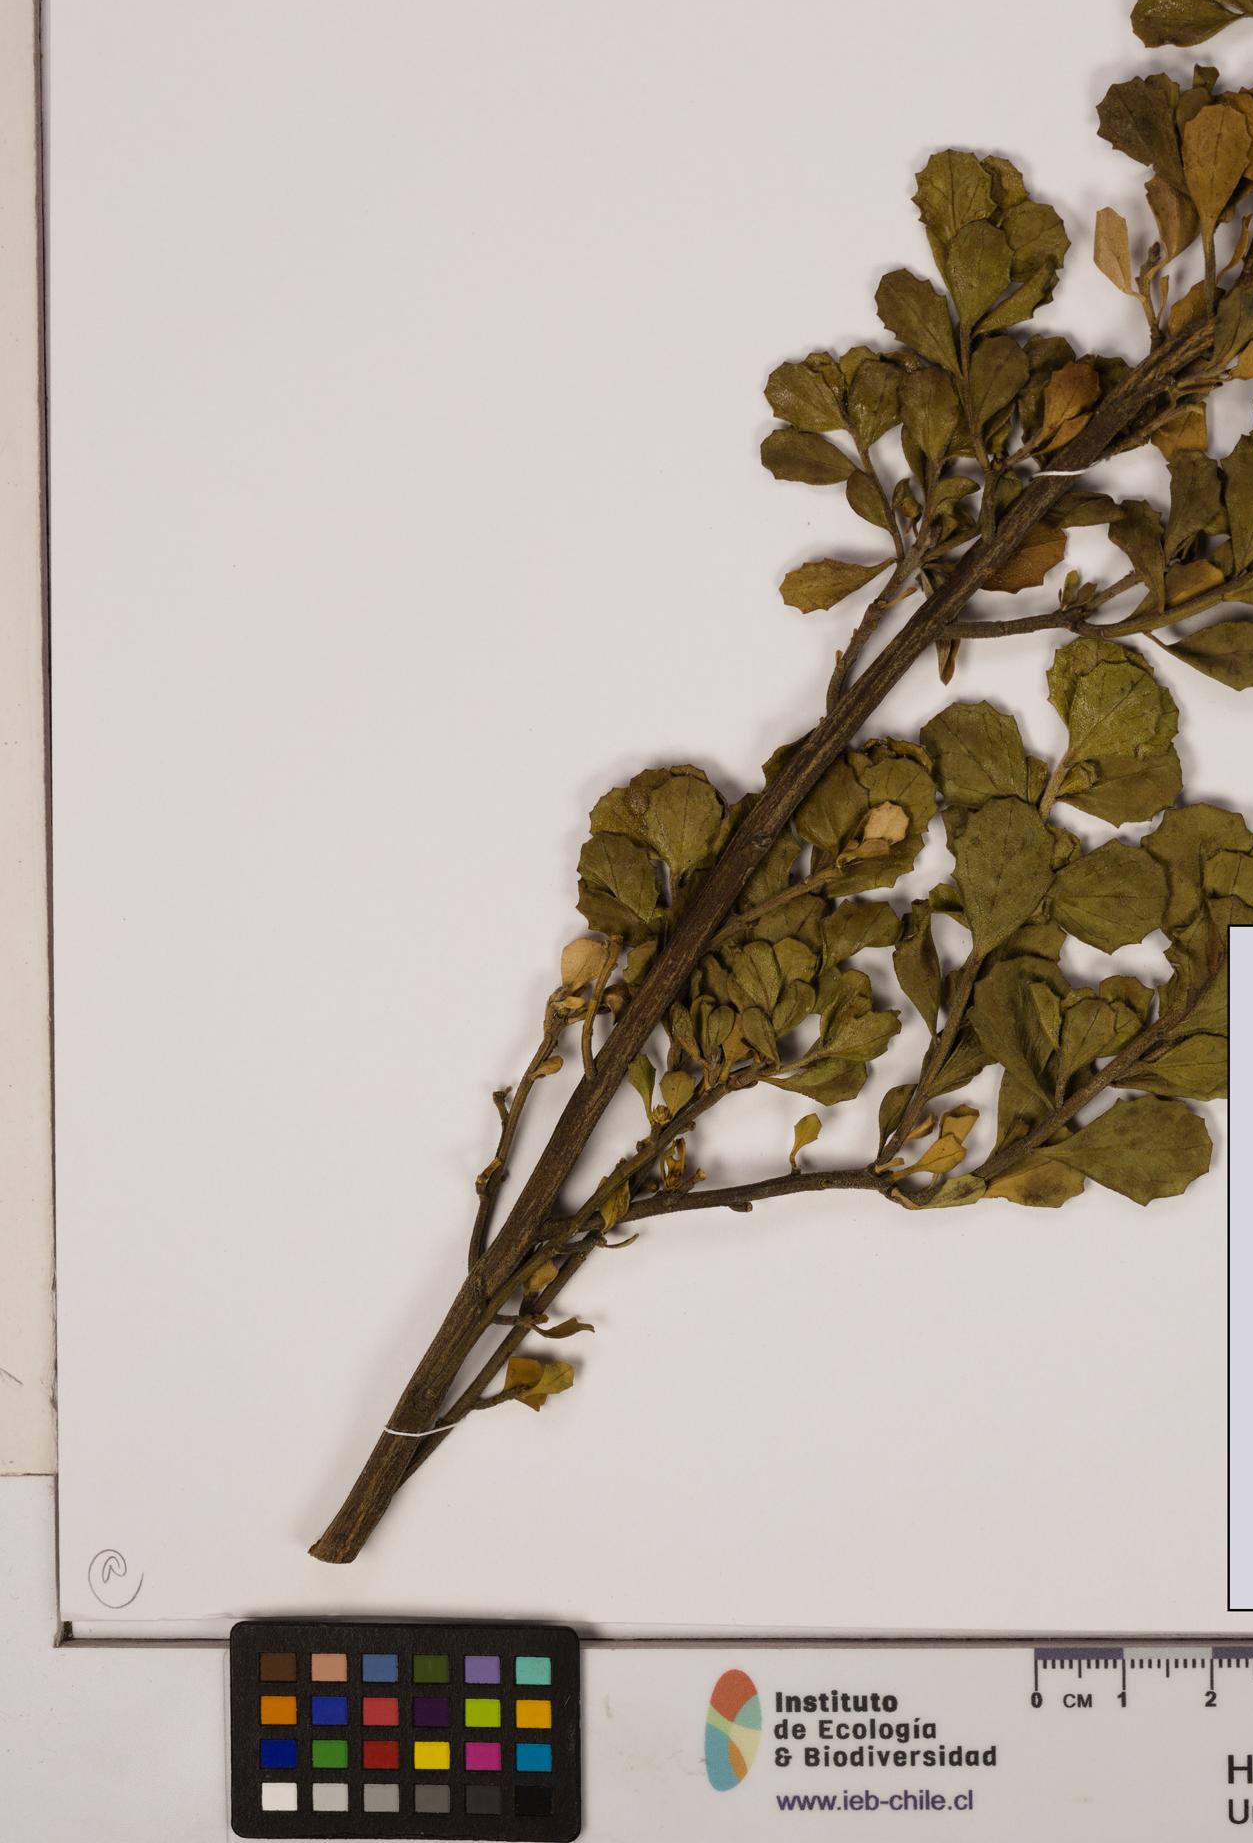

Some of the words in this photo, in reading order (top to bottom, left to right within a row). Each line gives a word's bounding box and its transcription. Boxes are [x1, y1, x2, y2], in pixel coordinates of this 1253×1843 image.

[775, 1689, 899, 1713] Instituto
[1030, 1692, 1043, 1709] 0
[1062, 1693, 1093, 1709] CM
[1116, 1691, 1128, 1708] 1
[1204, 1691, 1217, 1708] 2
[773, 1718, 807, 1740] de
[818, 1717, 937, 1744] Ecología
[774, 1746, 793, 1768] &
[804, 1744, 997, 1768] Biodiversidad
[776, 1789, 974, 1811] www.ieb-chile.cl
